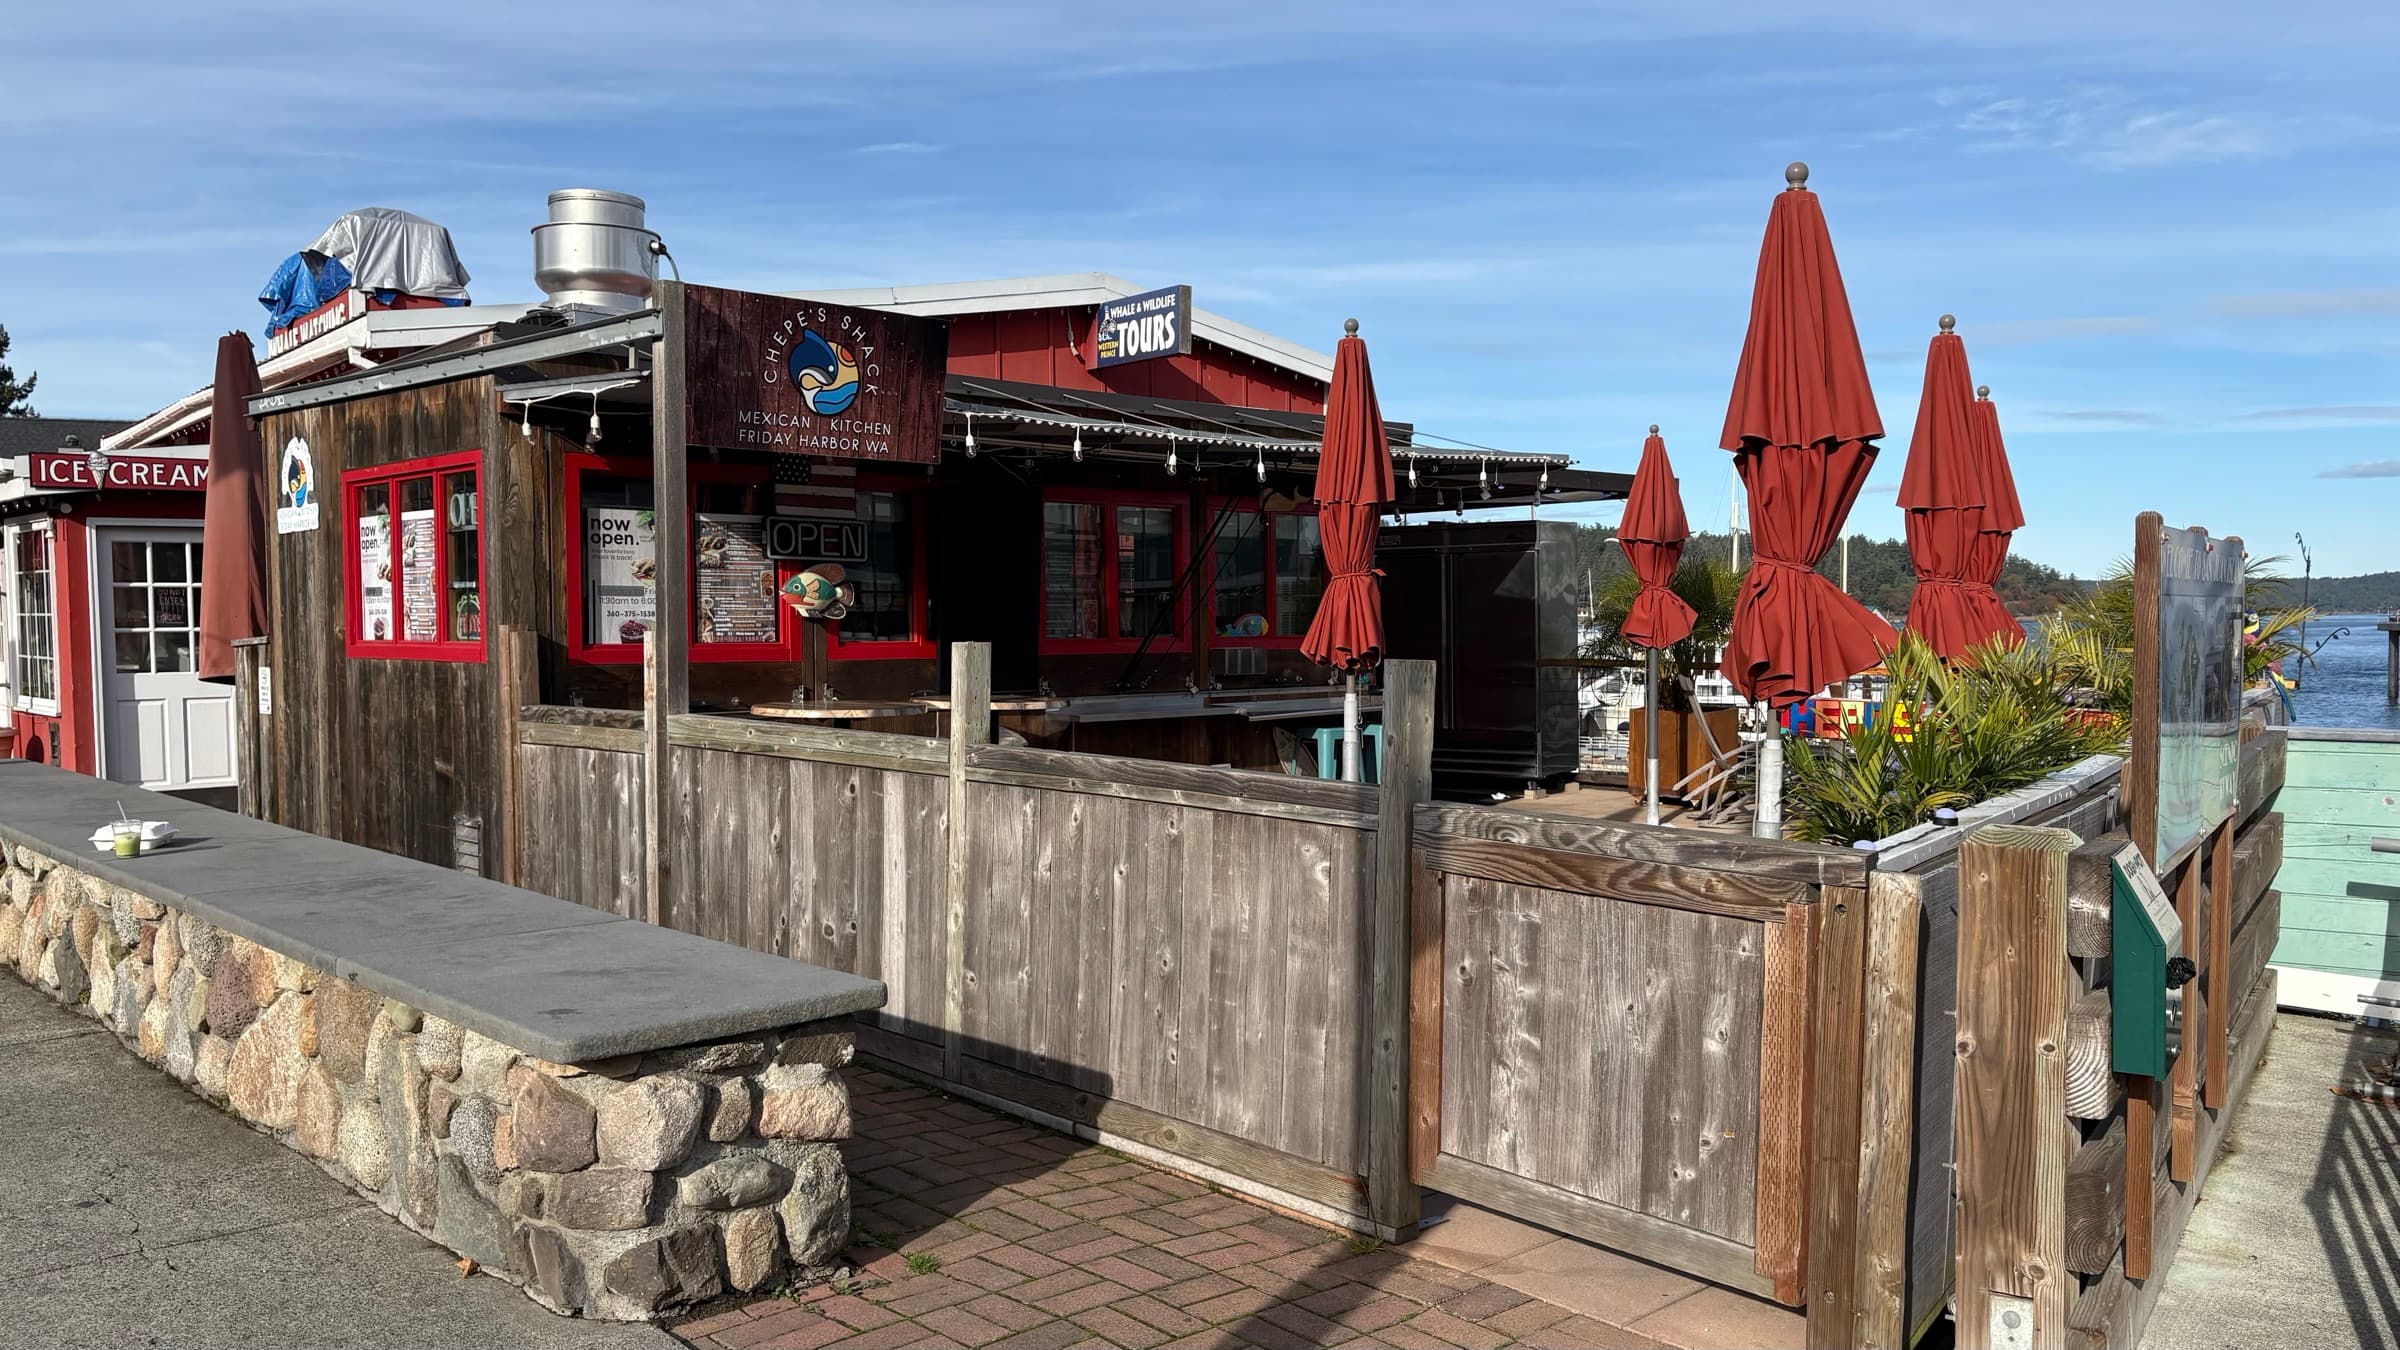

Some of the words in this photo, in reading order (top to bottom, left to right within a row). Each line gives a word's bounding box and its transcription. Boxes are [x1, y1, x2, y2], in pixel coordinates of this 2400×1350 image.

[1110, 303, 1136, 319] WHALE
[1137, 303, 1142, 313] &
[1142, 294, 1176, 312] WILDLIFE
[1117, 311, 1176, 358] TOURS
[764, 308, 826, 384] CHEPE'S
[841, 316, 880, 396] SHACK
[739, 410, 810, 429] MEXICAN
[831, 418, 891, 436] KITCHEN
[739, 429, 792, 446] FRIDAY
[800, 434, 859, 451] HARBOR
[865, 439, 889, 454] WA
[40, 459, 88, 483] ICE
[109, 462, 210, 487] CREAM
[361, 525, 376, 537] now
[591, 518, 630, 531] now
[361, 538, 380, 552] open.
[591, 533, 640, 548] open.
[774, 522, 862, 557] OPEN
[631, 597, 639, 605] to
[645, 587, 656, 595] Fri
